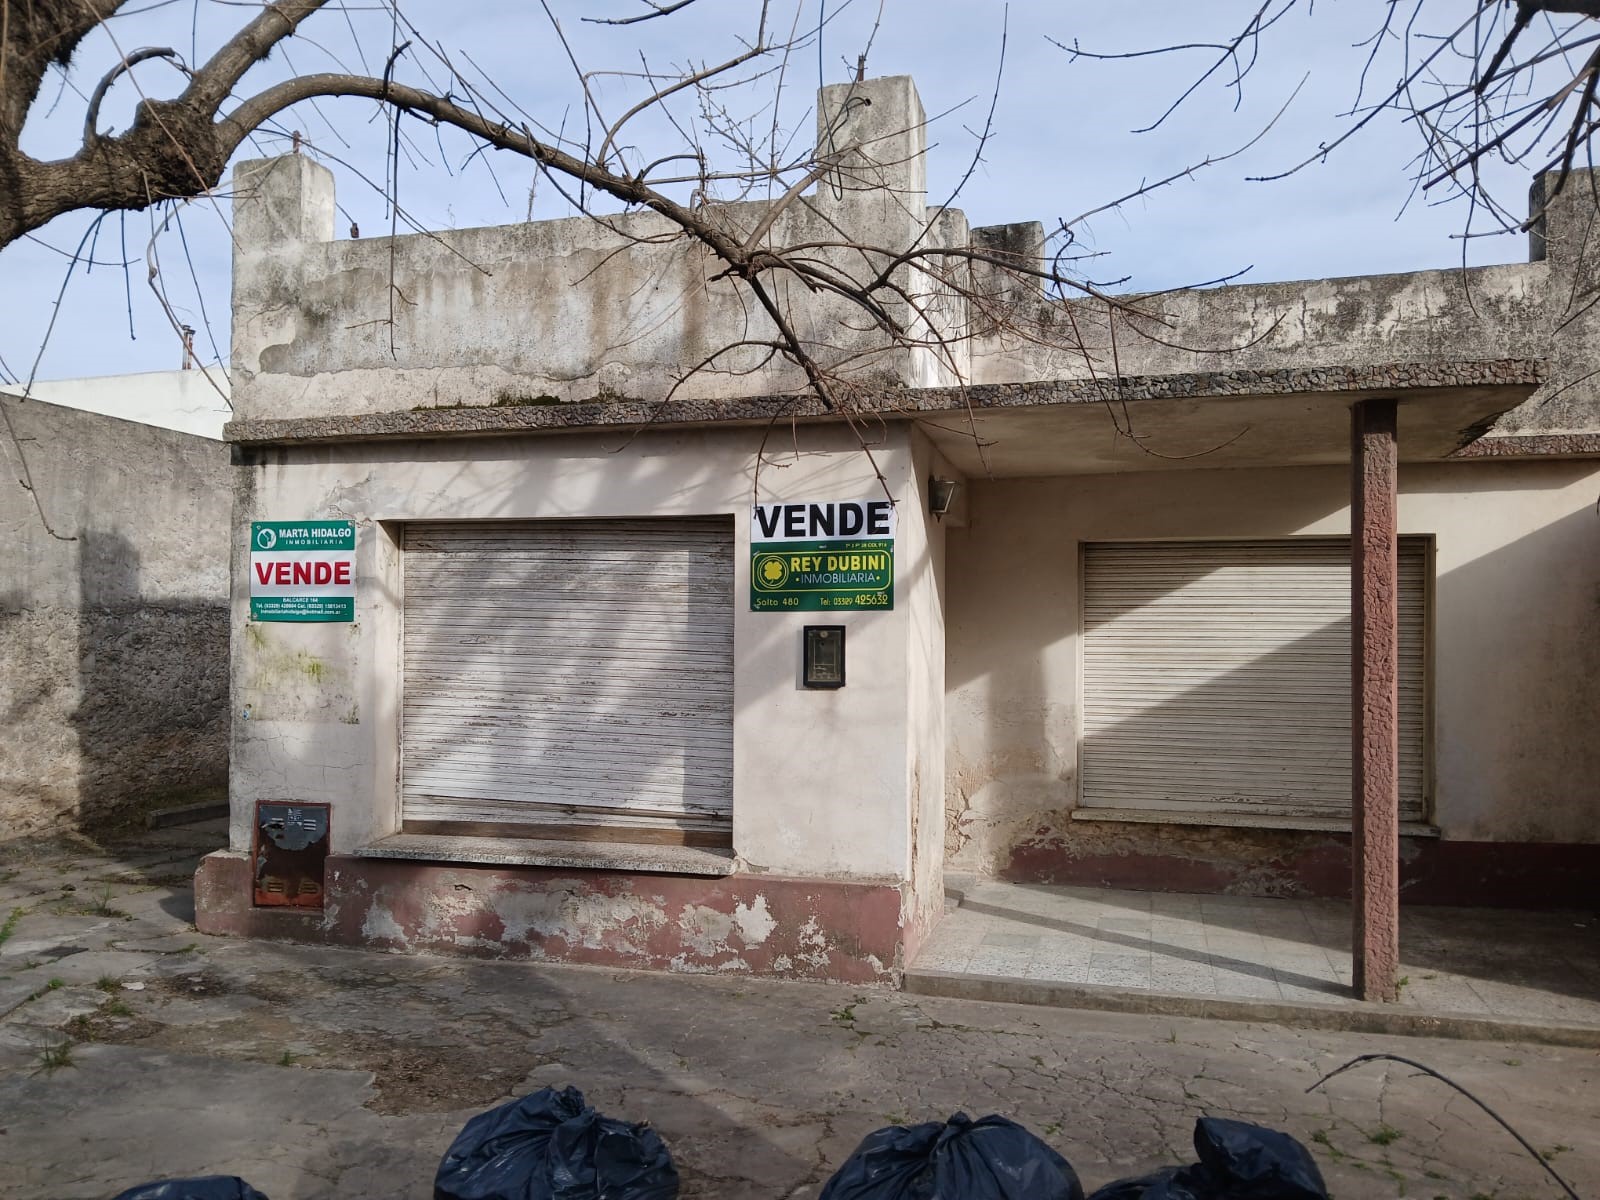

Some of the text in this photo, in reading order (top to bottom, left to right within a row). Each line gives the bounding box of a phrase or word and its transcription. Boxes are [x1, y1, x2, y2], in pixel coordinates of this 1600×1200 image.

[756, 501, 890, 538] VENDE
[279, 527, 351, 538] MARTA HIDALGO
[790, 554, 885, 572] REY DUBINI
[255, 561, 351, 585] VENDE
[801, 572, 875, 584] INMOBILIARIA
[756, 597, 799, 606] Salto 480
[820, 594, 888, 606] Tel: 03329 425632
